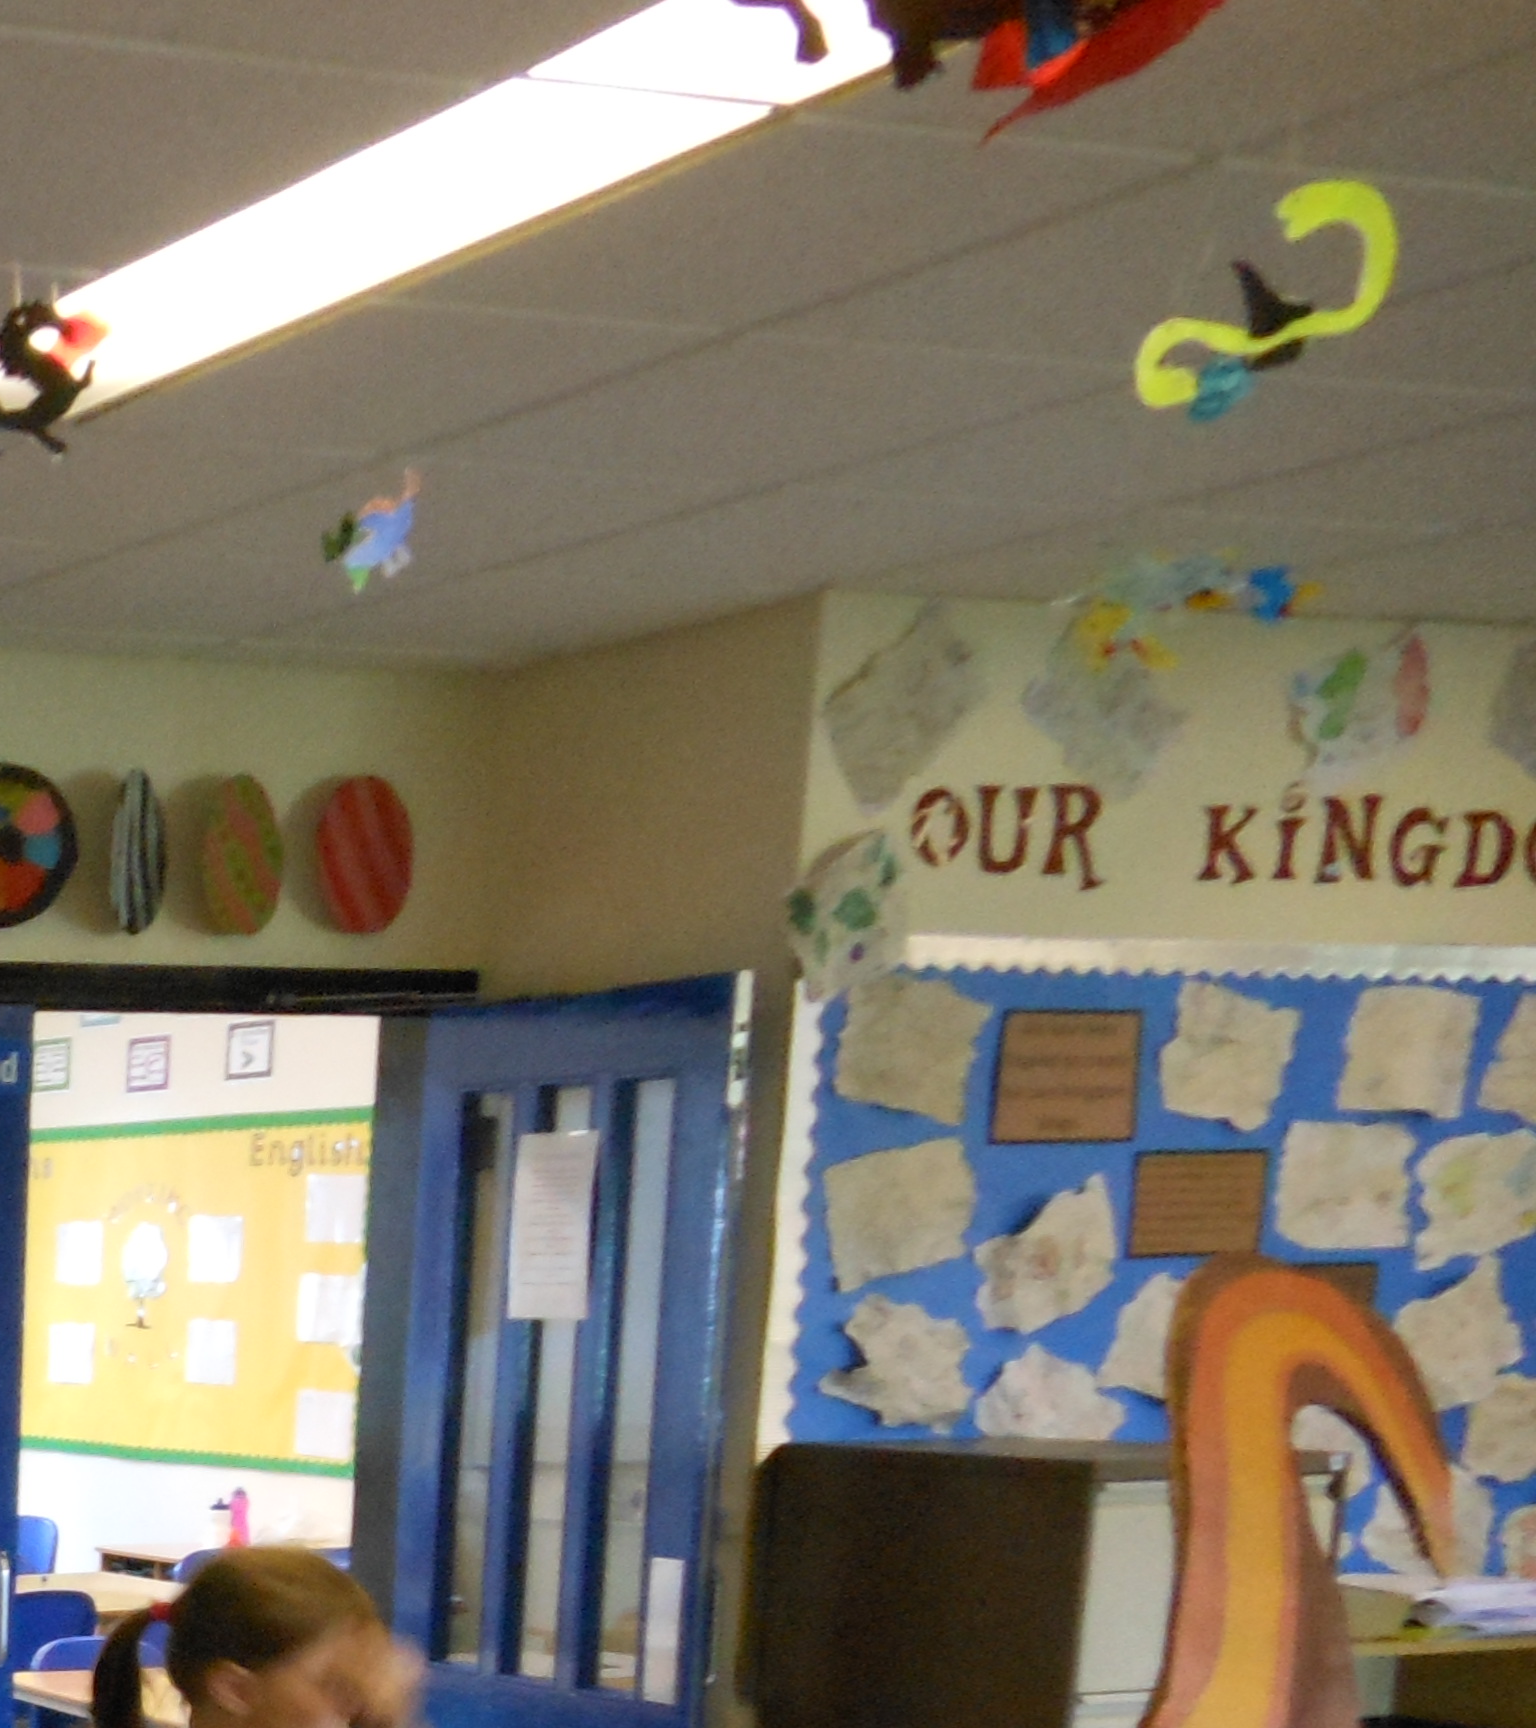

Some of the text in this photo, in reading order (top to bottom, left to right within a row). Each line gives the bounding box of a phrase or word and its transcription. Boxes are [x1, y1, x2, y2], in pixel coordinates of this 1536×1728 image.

[911, 781, 1536, 891] OUR KINGD
[248, 1132, 366, 1177] English
